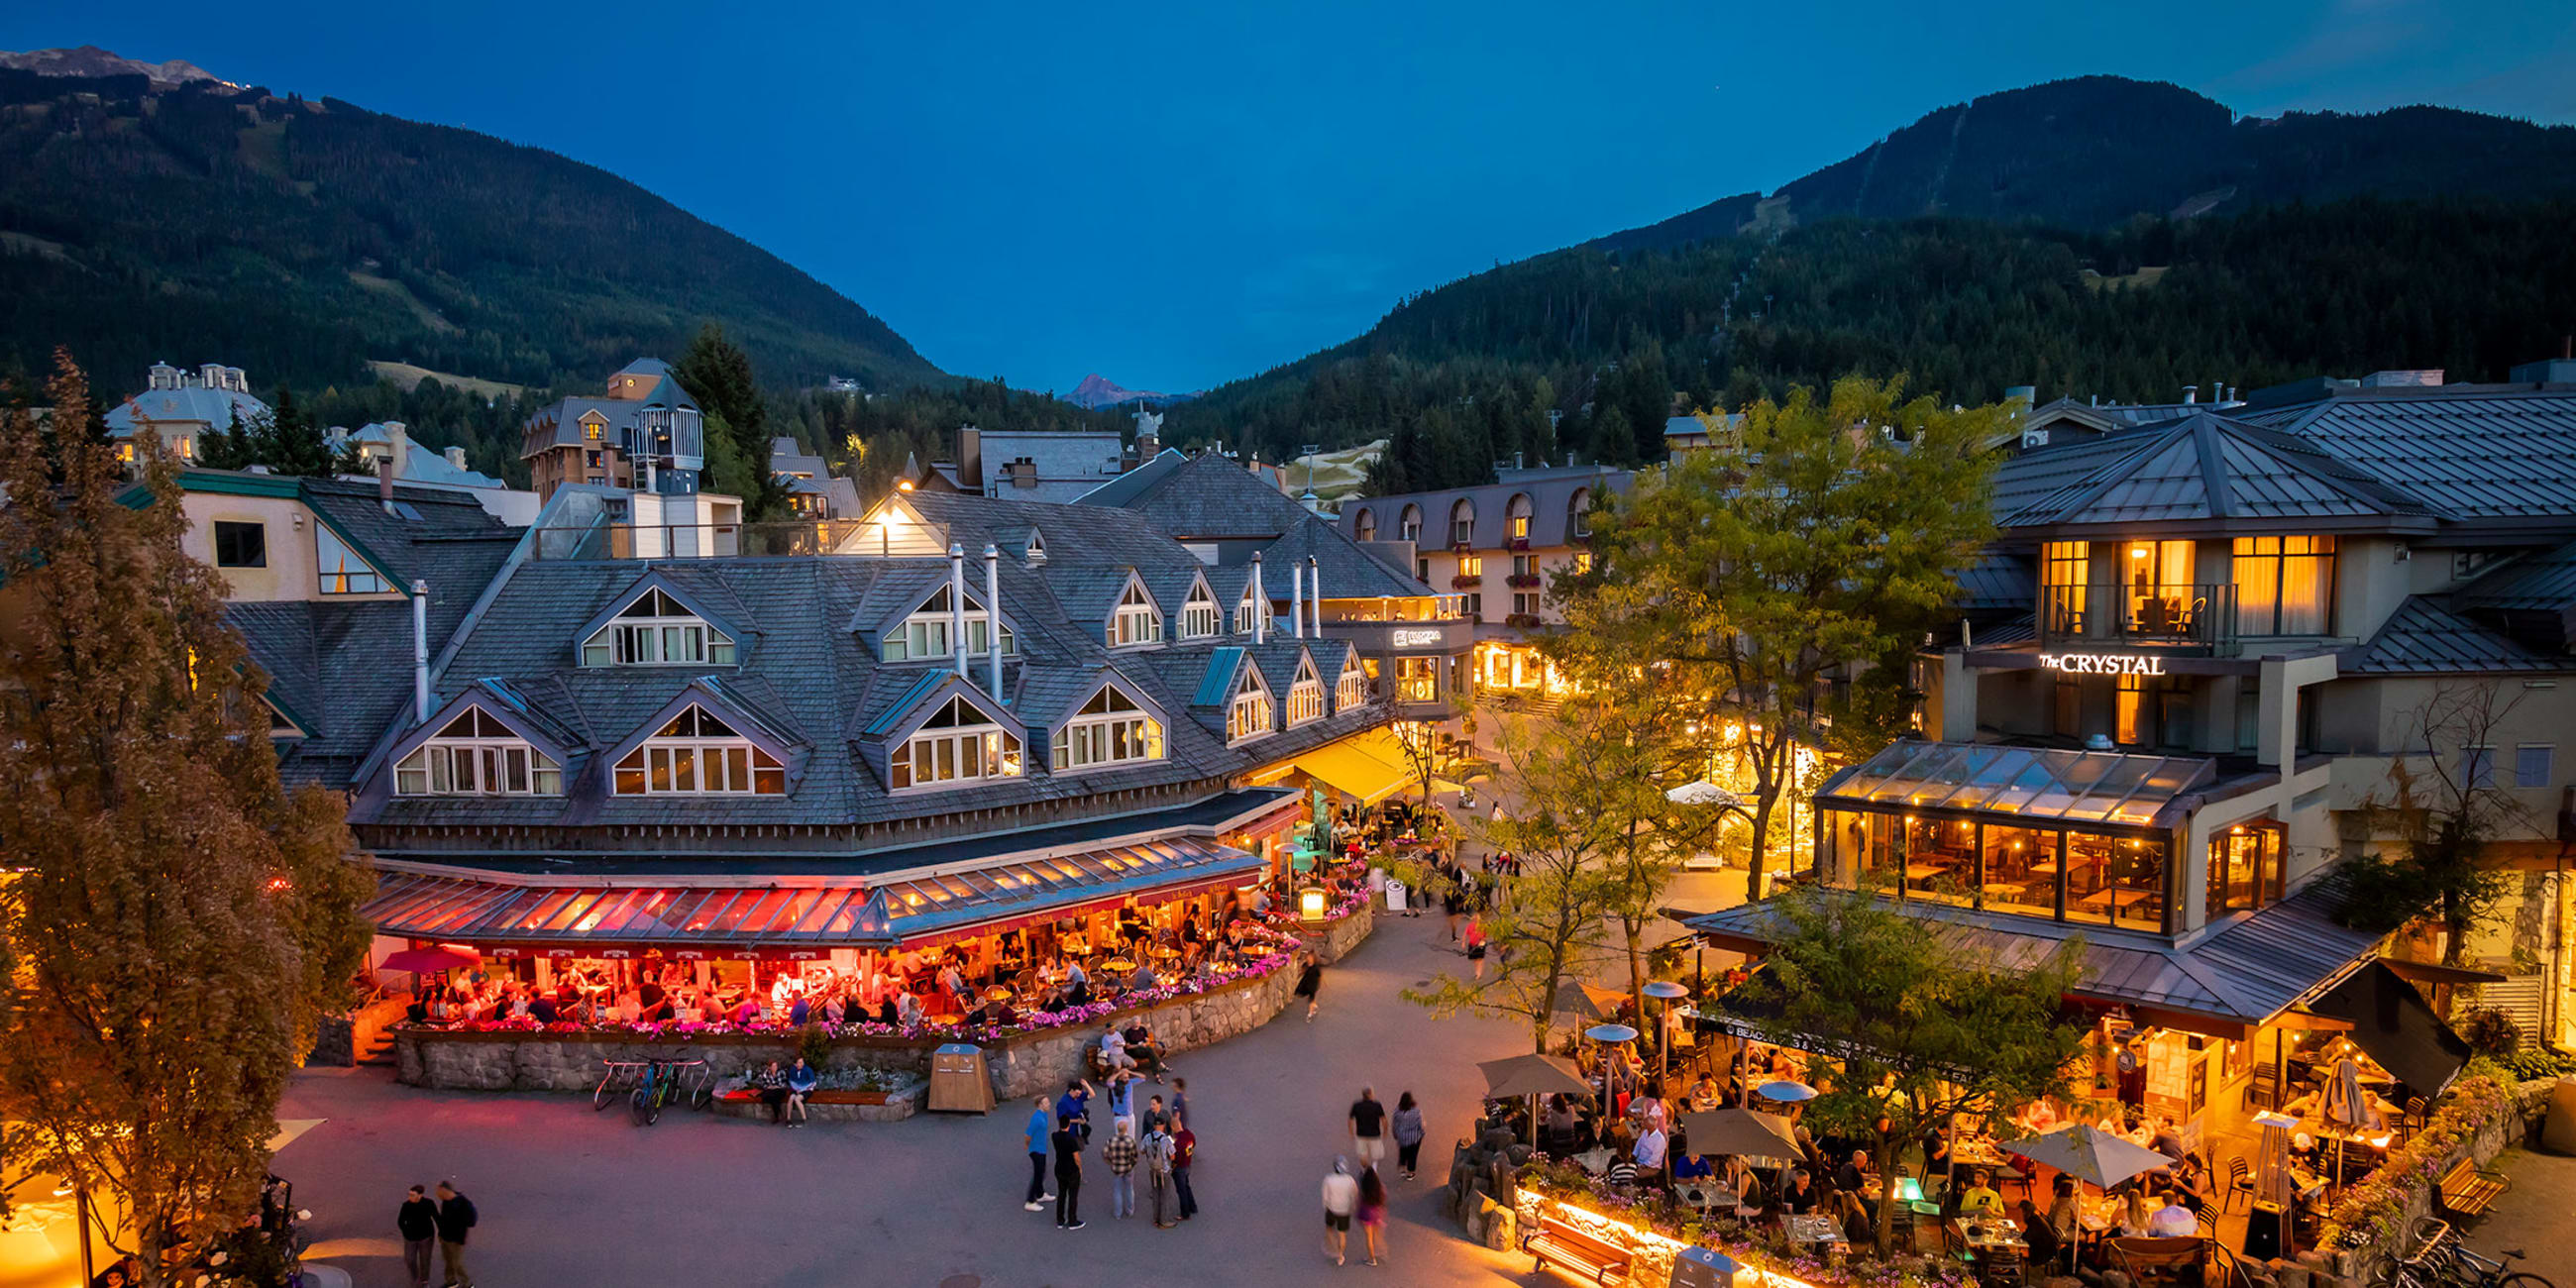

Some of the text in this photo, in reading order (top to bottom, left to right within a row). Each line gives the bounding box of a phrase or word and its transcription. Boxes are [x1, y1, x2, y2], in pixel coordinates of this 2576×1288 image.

[2039, 654, 2166, 676] The CRYSTAL
[1736, 1026, 1776, 1044] BEAC
